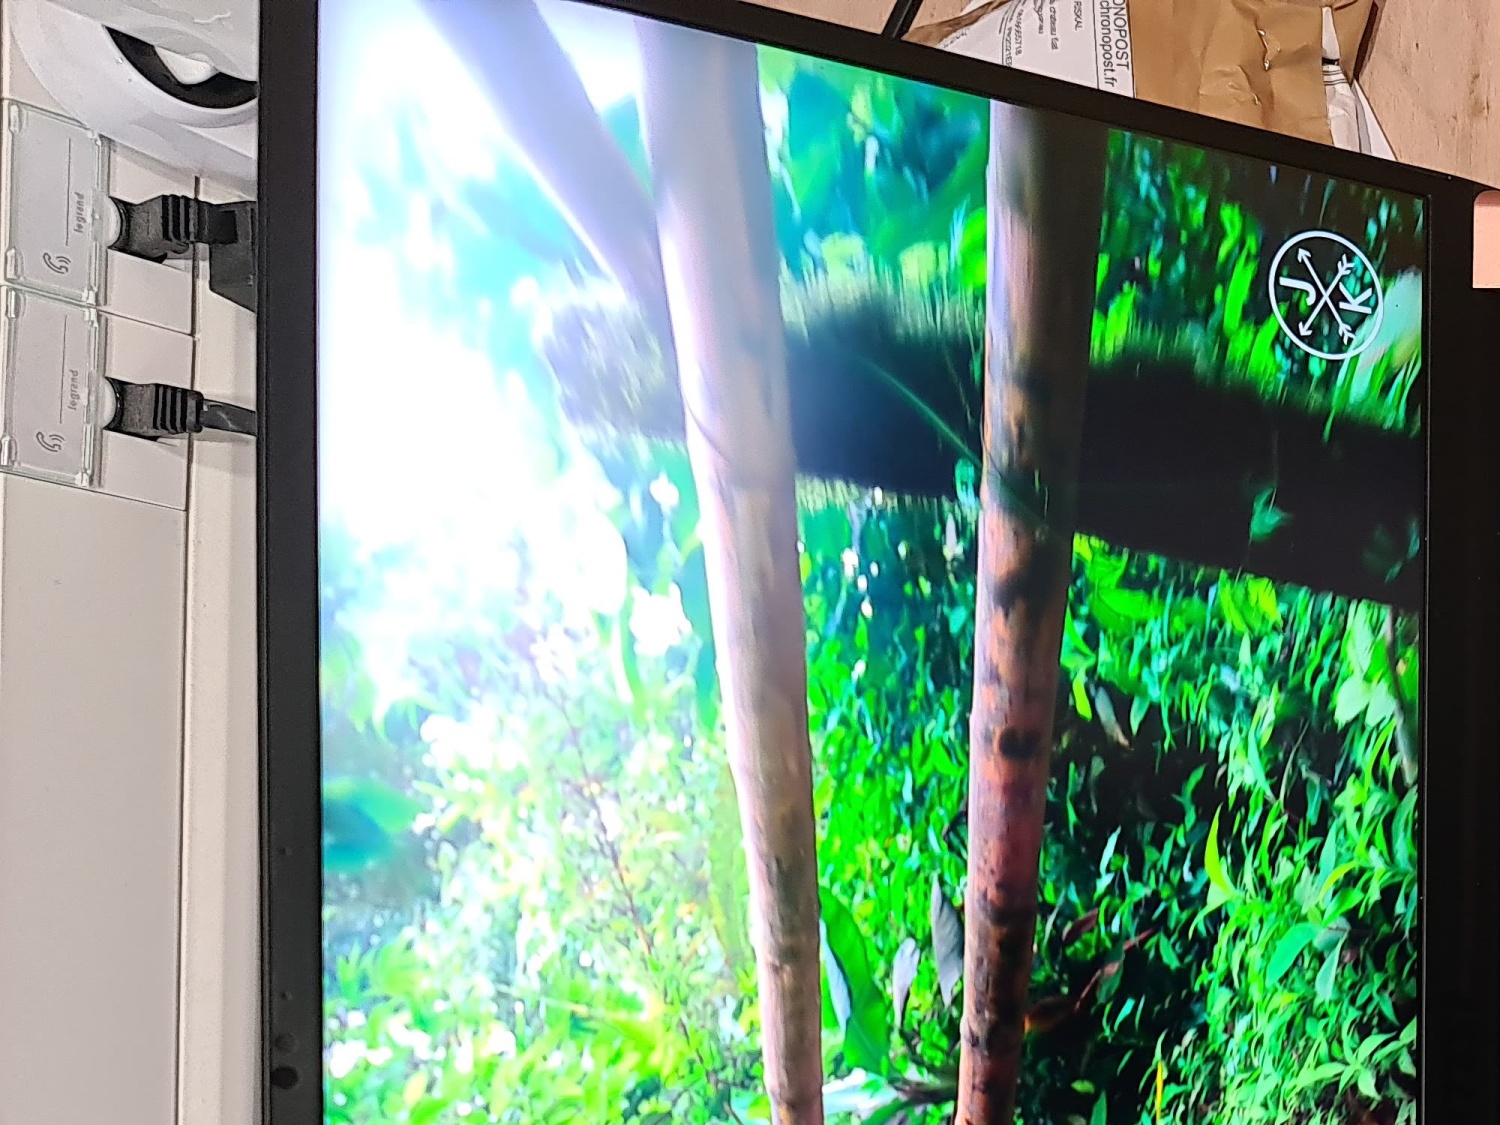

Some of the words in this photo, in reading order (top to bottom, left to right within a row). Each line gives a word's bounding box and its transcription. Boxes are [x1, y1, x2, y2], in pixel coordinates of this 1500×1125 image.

[73, 192, 86, 233] legrand
[1339, 281, 1373, 315] K
[67, 370, 80, 411] legrand
